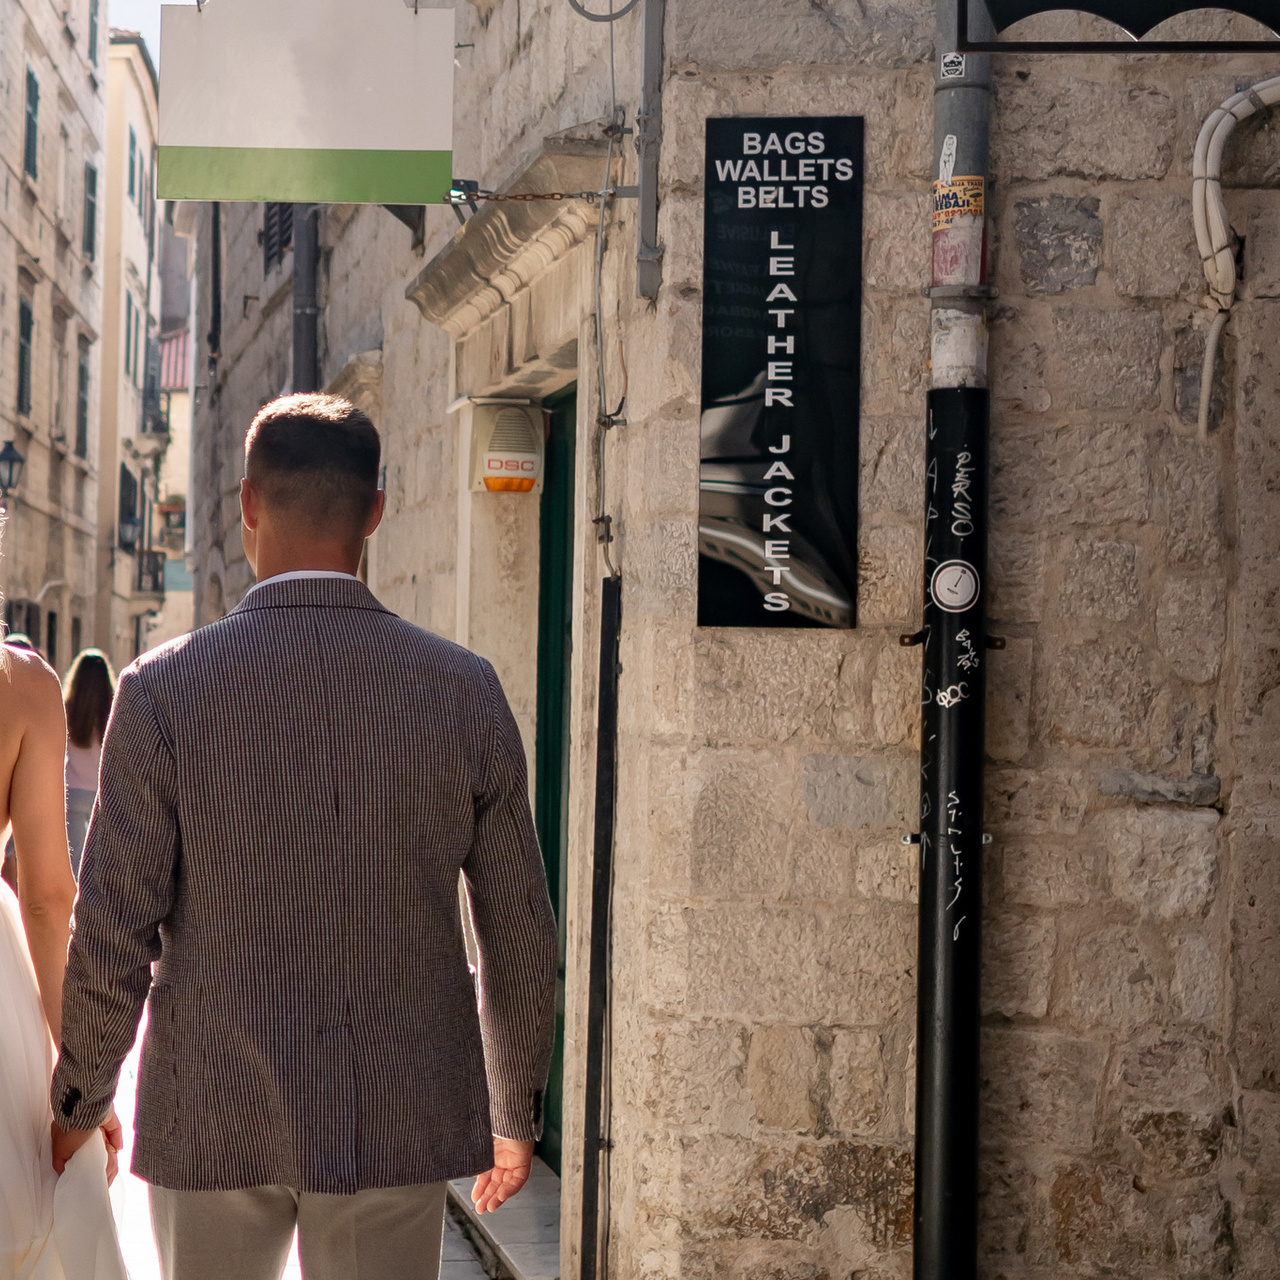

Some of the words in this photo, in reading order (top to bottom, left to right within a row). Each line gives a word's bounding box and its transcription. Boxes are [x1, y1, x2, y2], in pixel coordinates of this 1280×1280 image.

[743, 131, 826, 155] BAGS
[715, 157, 854, 182] WALLETS
[738, 185, 829, 209] BELTS
[765, 231, 798, 407] LEATHER
[487, 458, 535, 472] DSC
[762, 434, 795, 612] JACKETS
